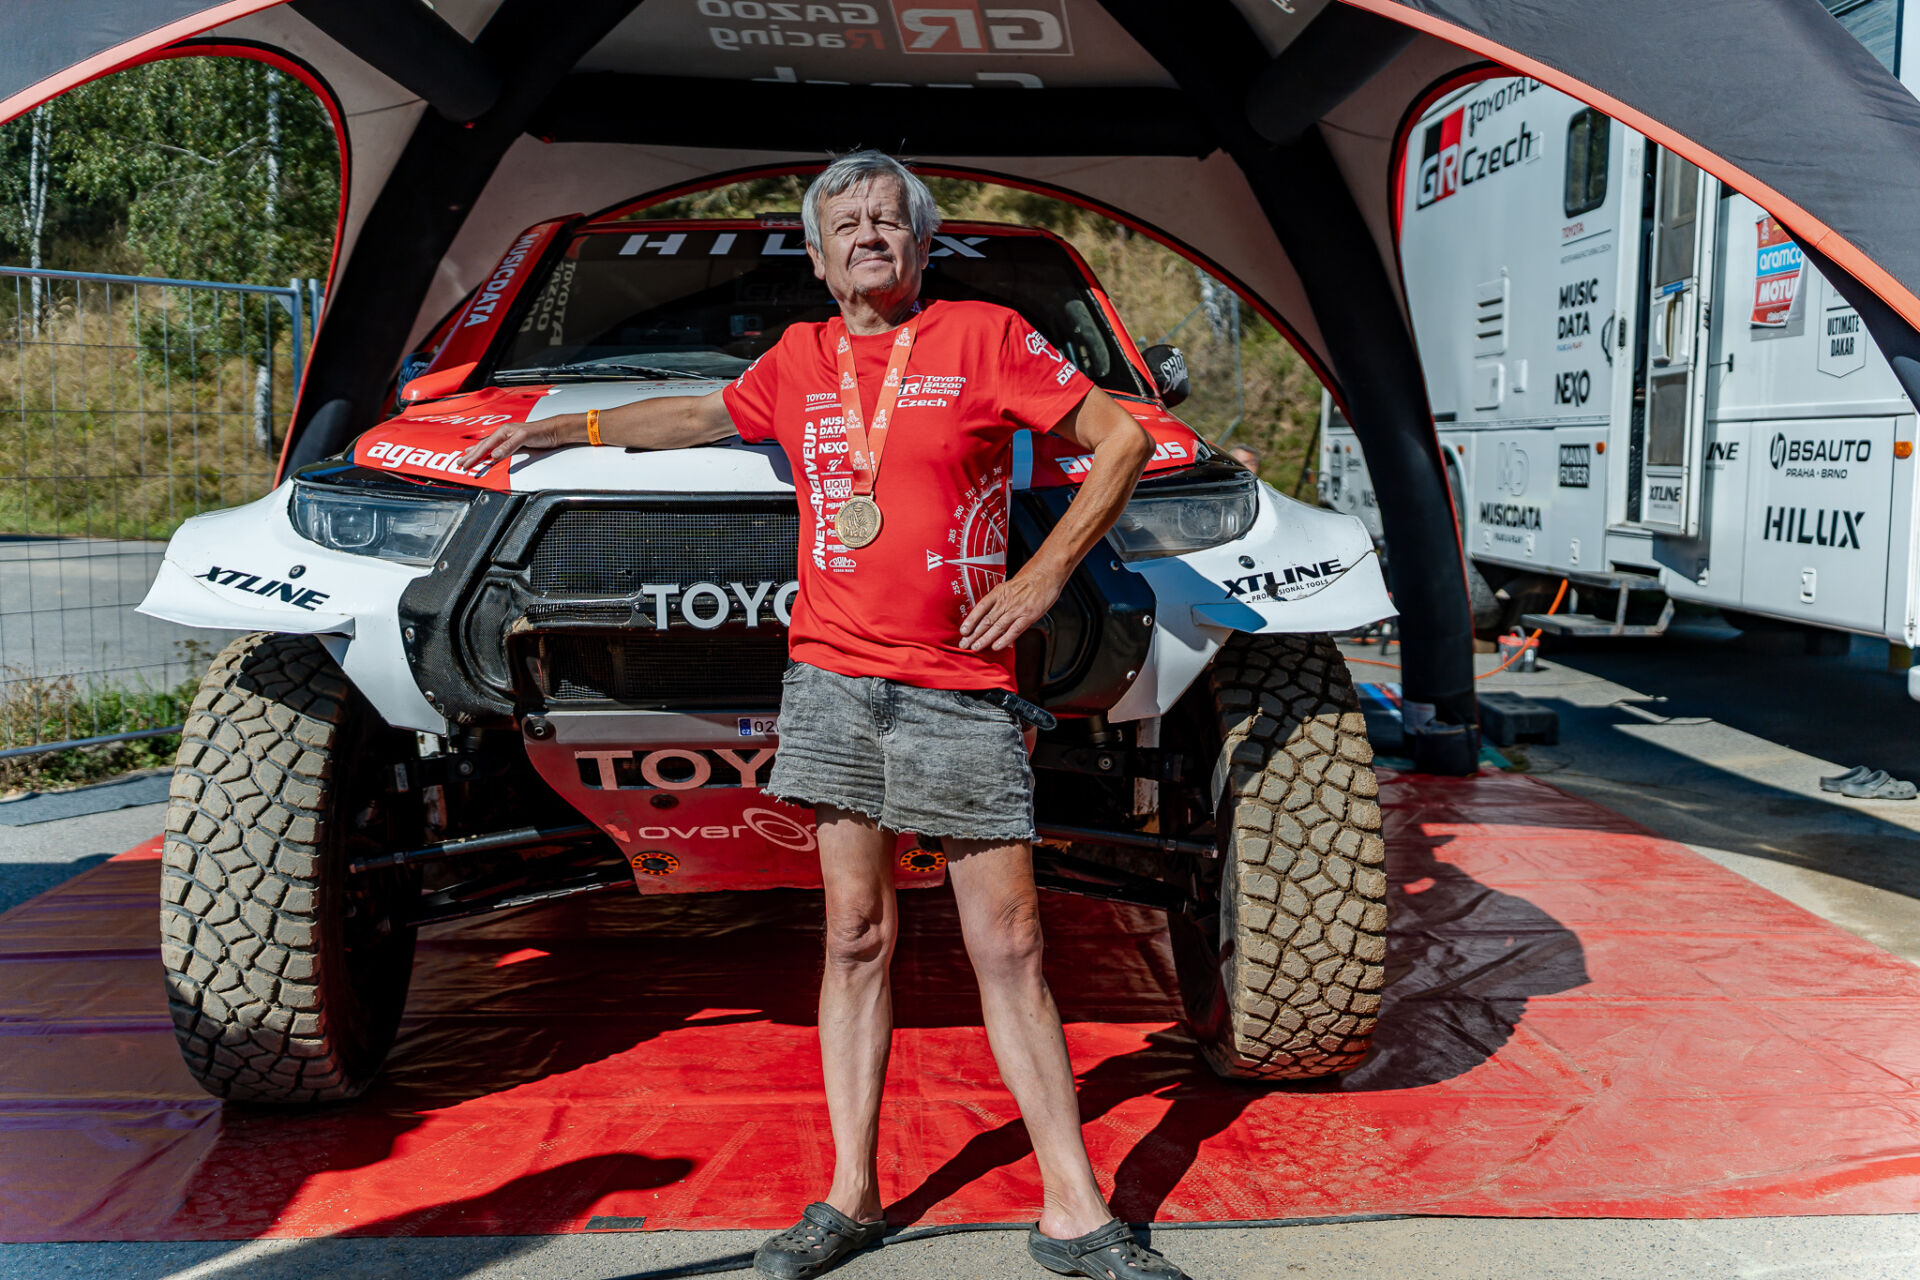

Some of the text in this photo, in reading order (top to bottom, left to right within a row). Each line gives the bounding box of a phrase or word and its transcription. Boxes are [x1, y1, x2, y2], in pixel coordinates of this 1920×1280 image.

[1462, 121, 1532, 186] Czech
[1417, 143, 1459, 208] GR
[619, 234, 990, 258] HILX
[464, 233, 540, 327] MUSICDATA
[1757, 278, 1794, 303] MOTU
[550, 262, 577, 346] TOYOTA
[1559, 278, 1598, 309] MUSIC
[1557, 311, 1591, 340] DATA
[1827, 314, 1859, 336] ULTIMATE
[1831, 337, 1855, 357] DAKAR
[924, 375, 966, 383] TOYOTA
[1554, 369, 1590, 407] NEXO
[806, 393, 837, 402] TOYOTA
[897, 398, 947, 408] Czech
[921, 387, 960, 397] Racing
[820, 416, 844, 427] MUSI
[820, 426, 846, 435] DATA
[819, 441, 849, 454] NEXO
[1788, 440, 1871, 461] BSAUTO
[826, 480, 850, 489] LIQUI
[1785, 468, 1848, 479] PRAHA BRNO
[803, 422, 827, 570] #NEVERGIVEUP
[1480, 502, 1542, 530] MUSICDATA
[1763, 506, 1865, 549] HILUX
[194, 566, 331, 611] XTLINE
[1222, 559, 1342, 600] XTLINE
[1306, 579, 1329, 594] TOOLS
[754, 721, 779, 733] 02
